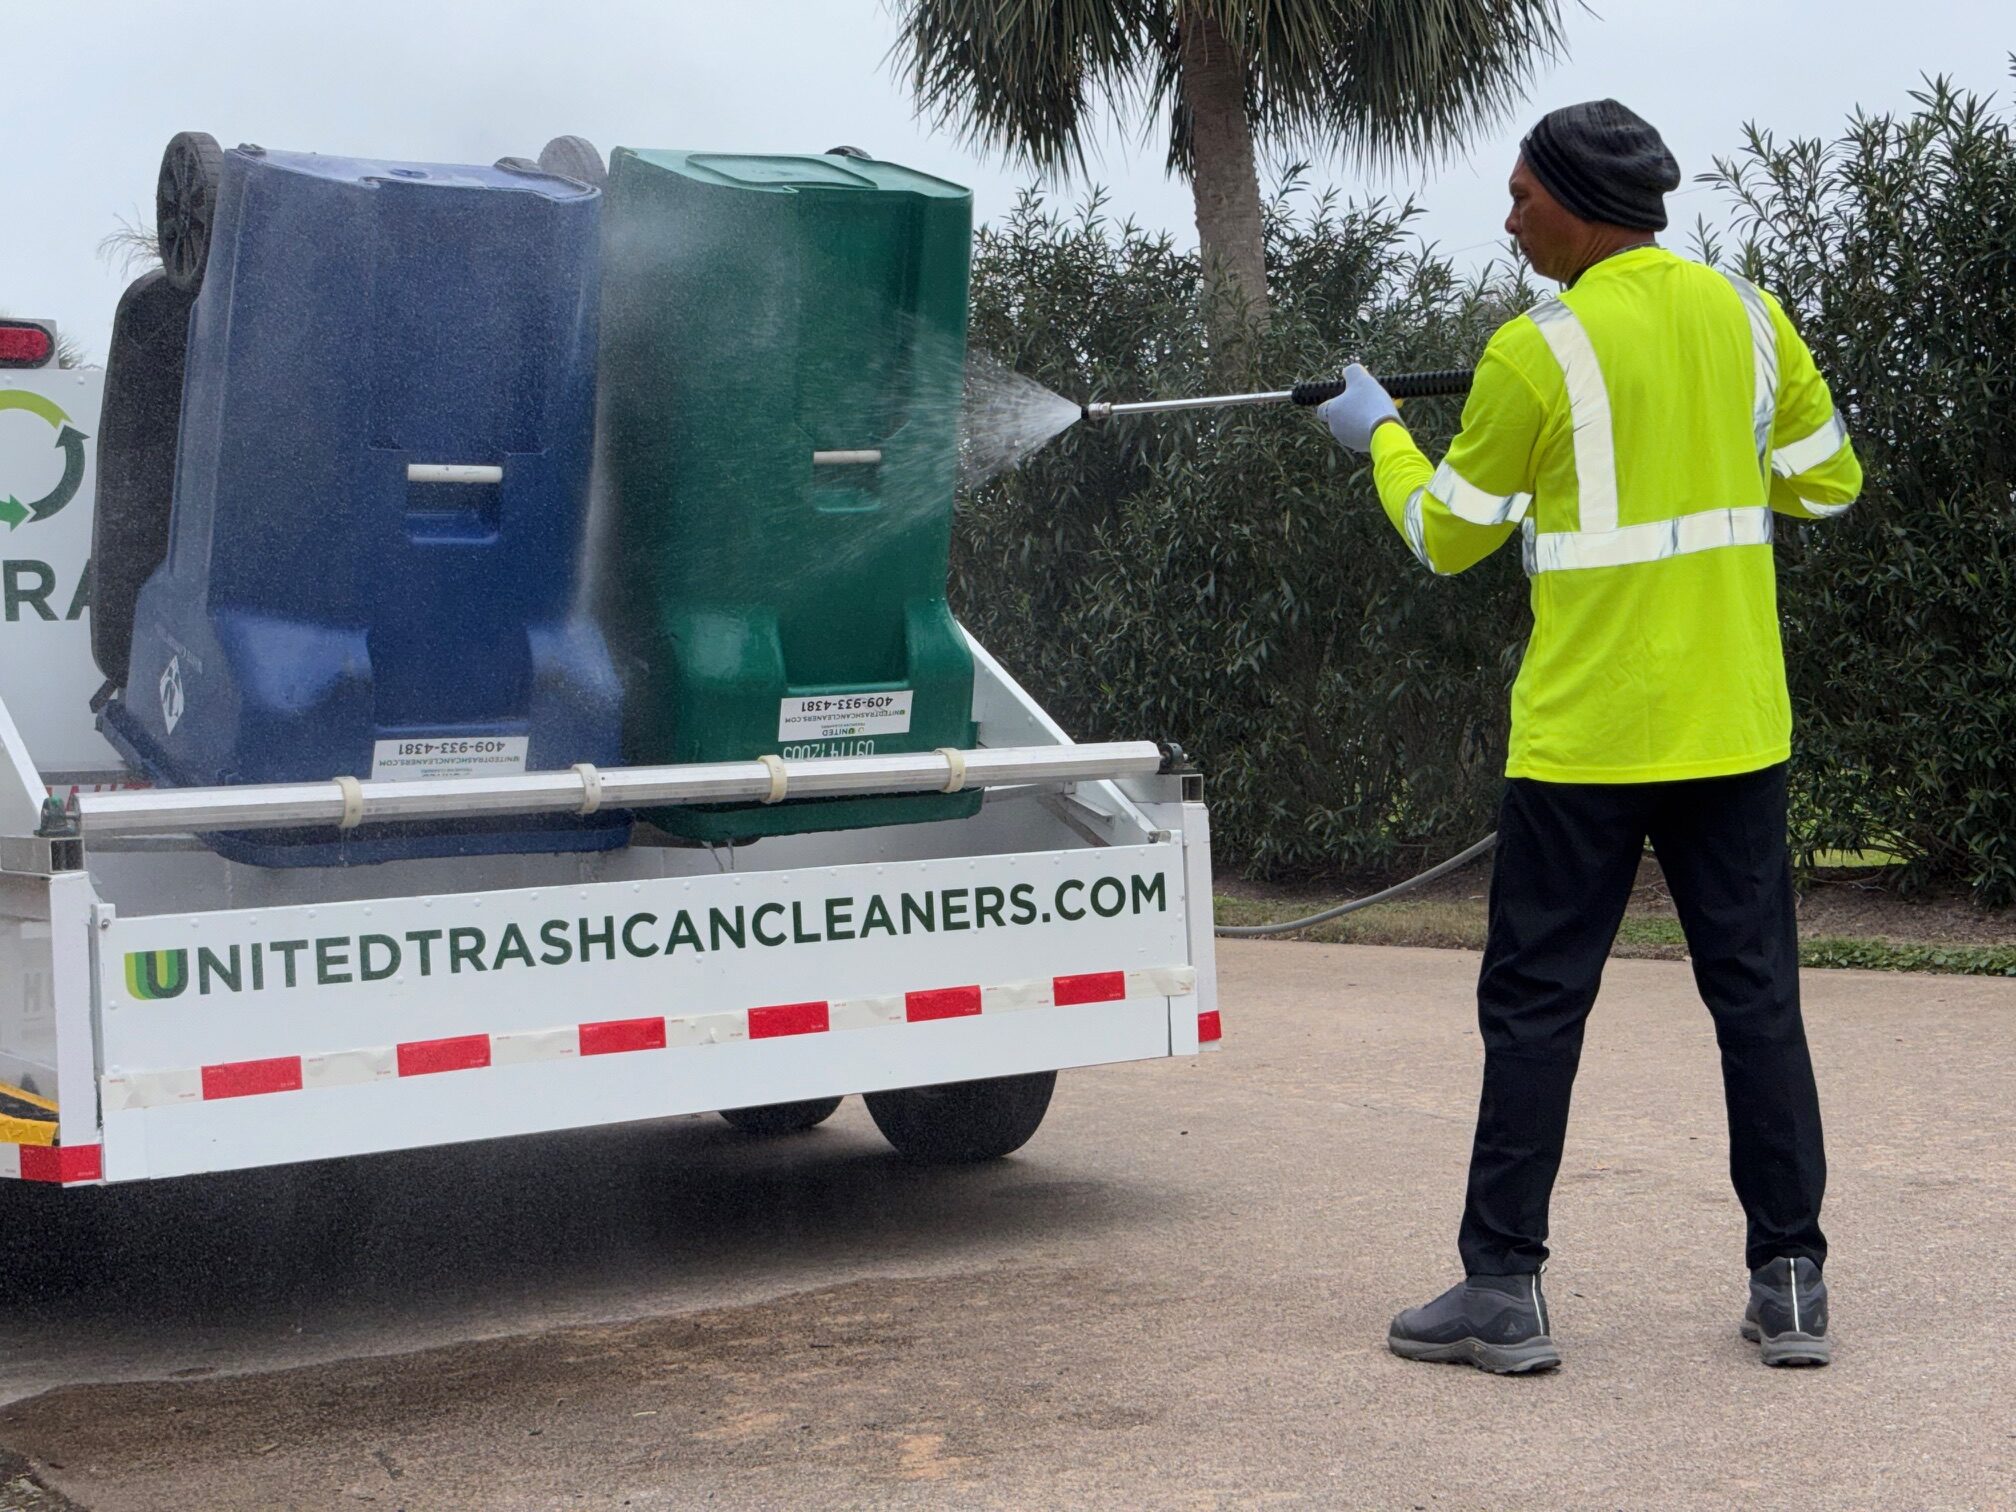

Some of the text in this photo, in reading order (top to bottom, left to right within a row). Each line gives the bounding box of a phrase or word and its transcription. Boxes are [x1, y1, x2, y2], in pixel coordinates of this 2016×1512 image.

[801, 696, 893, 713] 409-933-4381
[785, 709, 906, 723] UNITEDTRASHCANCLEANERS.COM
[822, 727, 856, 737] UNITED
[398, 741, 506, 756] 409-933-4381
[379, 755, 521, 767] UNITEDTRASHCANCLEANERS.COM
[124, 872, 1167, 1000] UNITEDTRASHCANCLEANERS.COM
